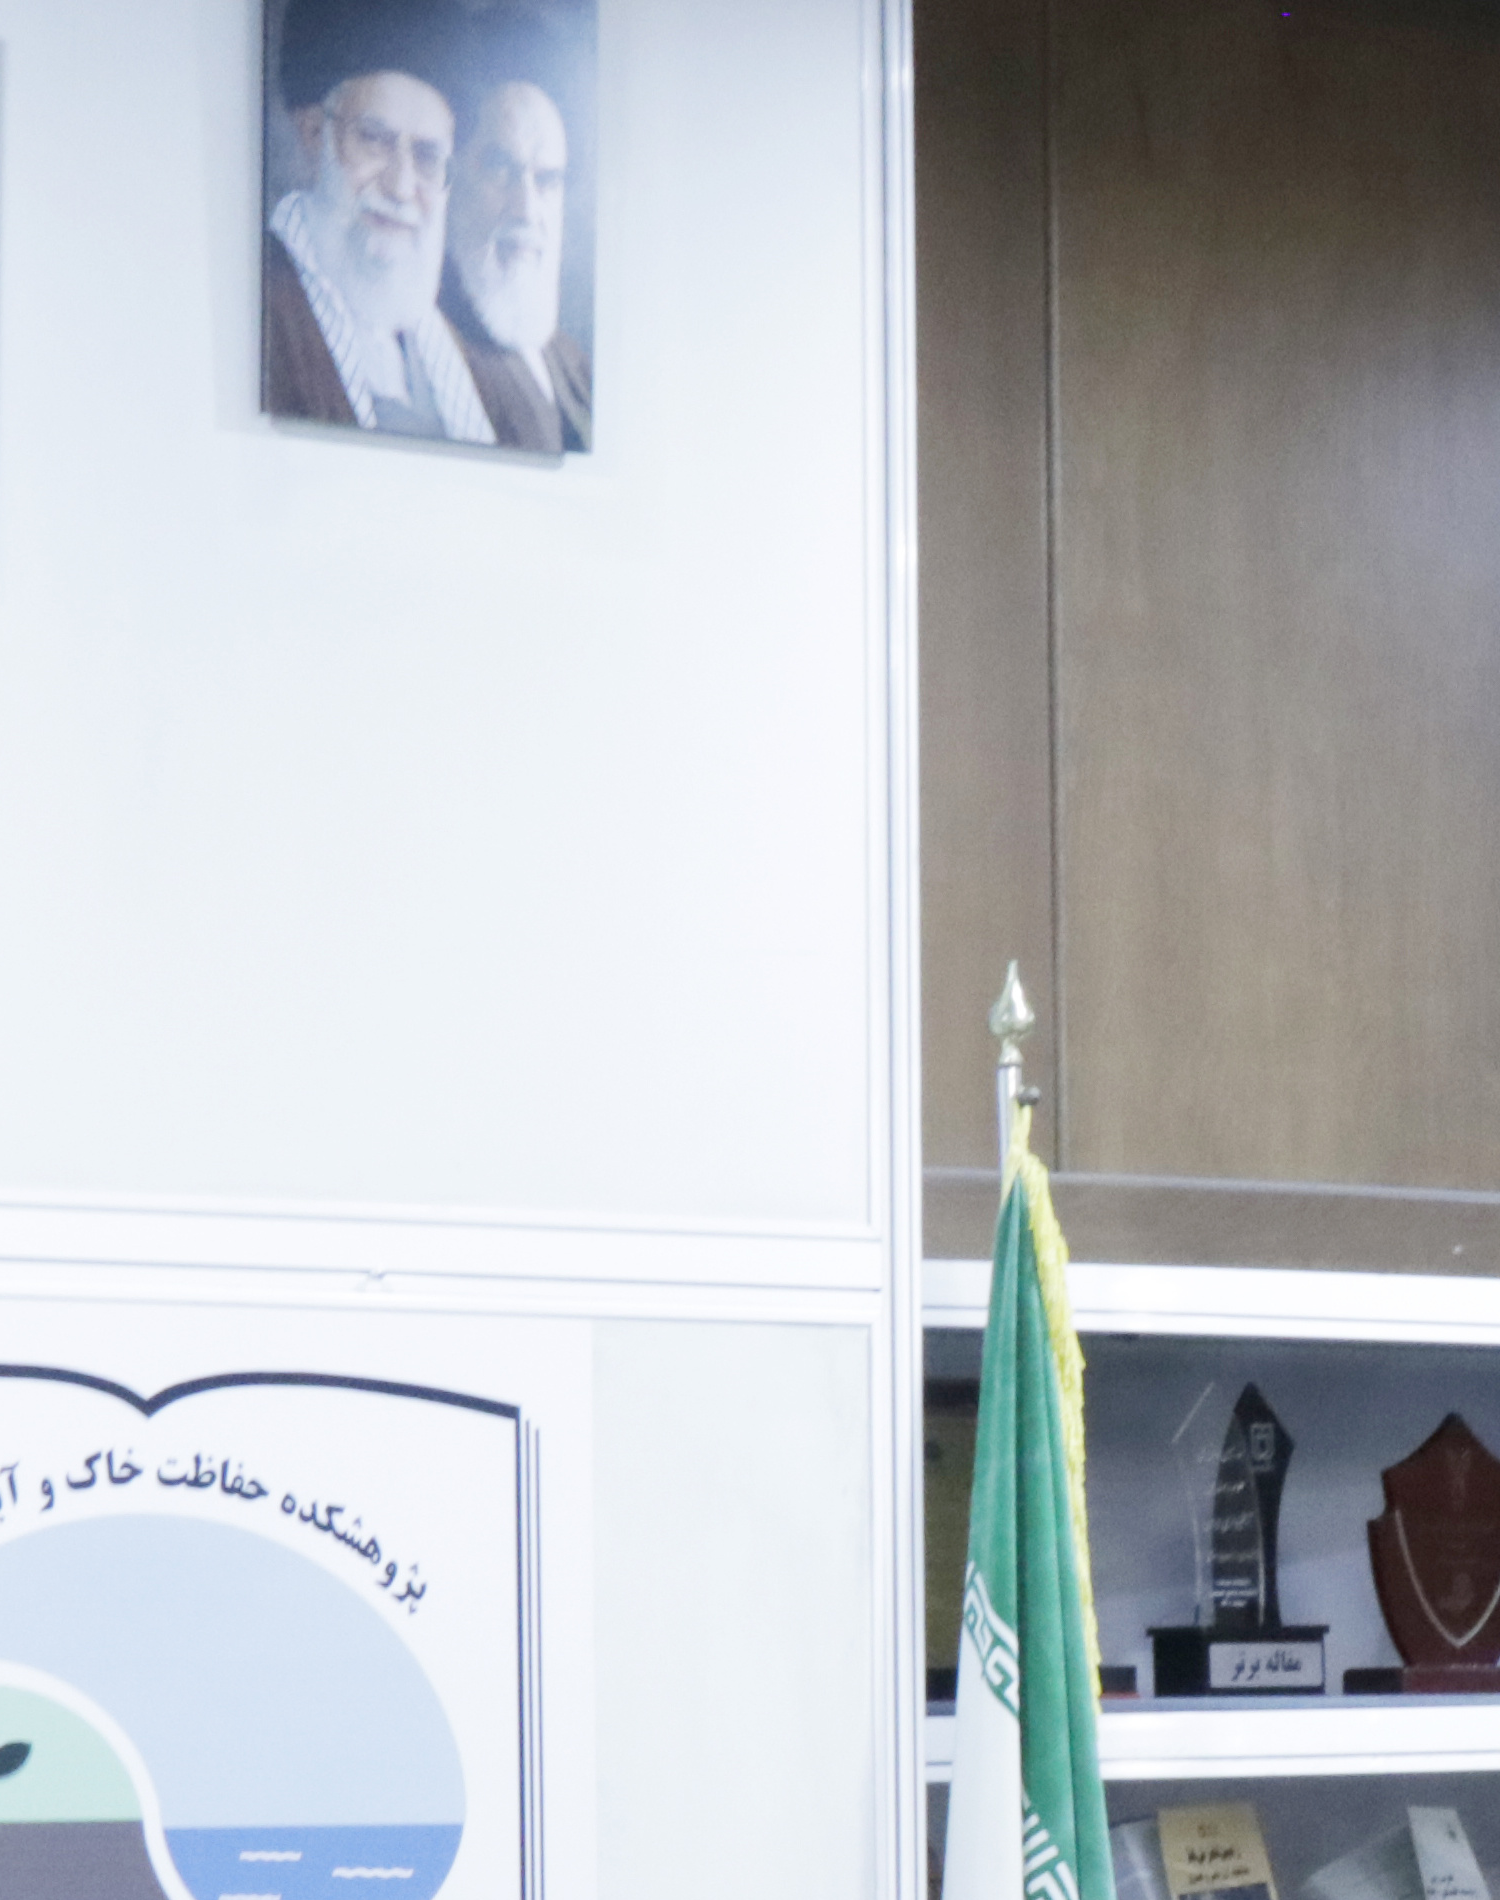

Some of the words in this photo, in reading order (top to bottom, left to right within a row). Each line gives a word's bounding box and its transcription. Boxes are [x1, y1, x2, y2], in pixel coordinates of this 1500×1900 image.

[65, 1449, 143, 1492] خاک
[156, 1451, 269, 1503] حفاظت
[40, 1478, 56, 1511] و
[280, 1493, 427, 1615] پژوهشکده
